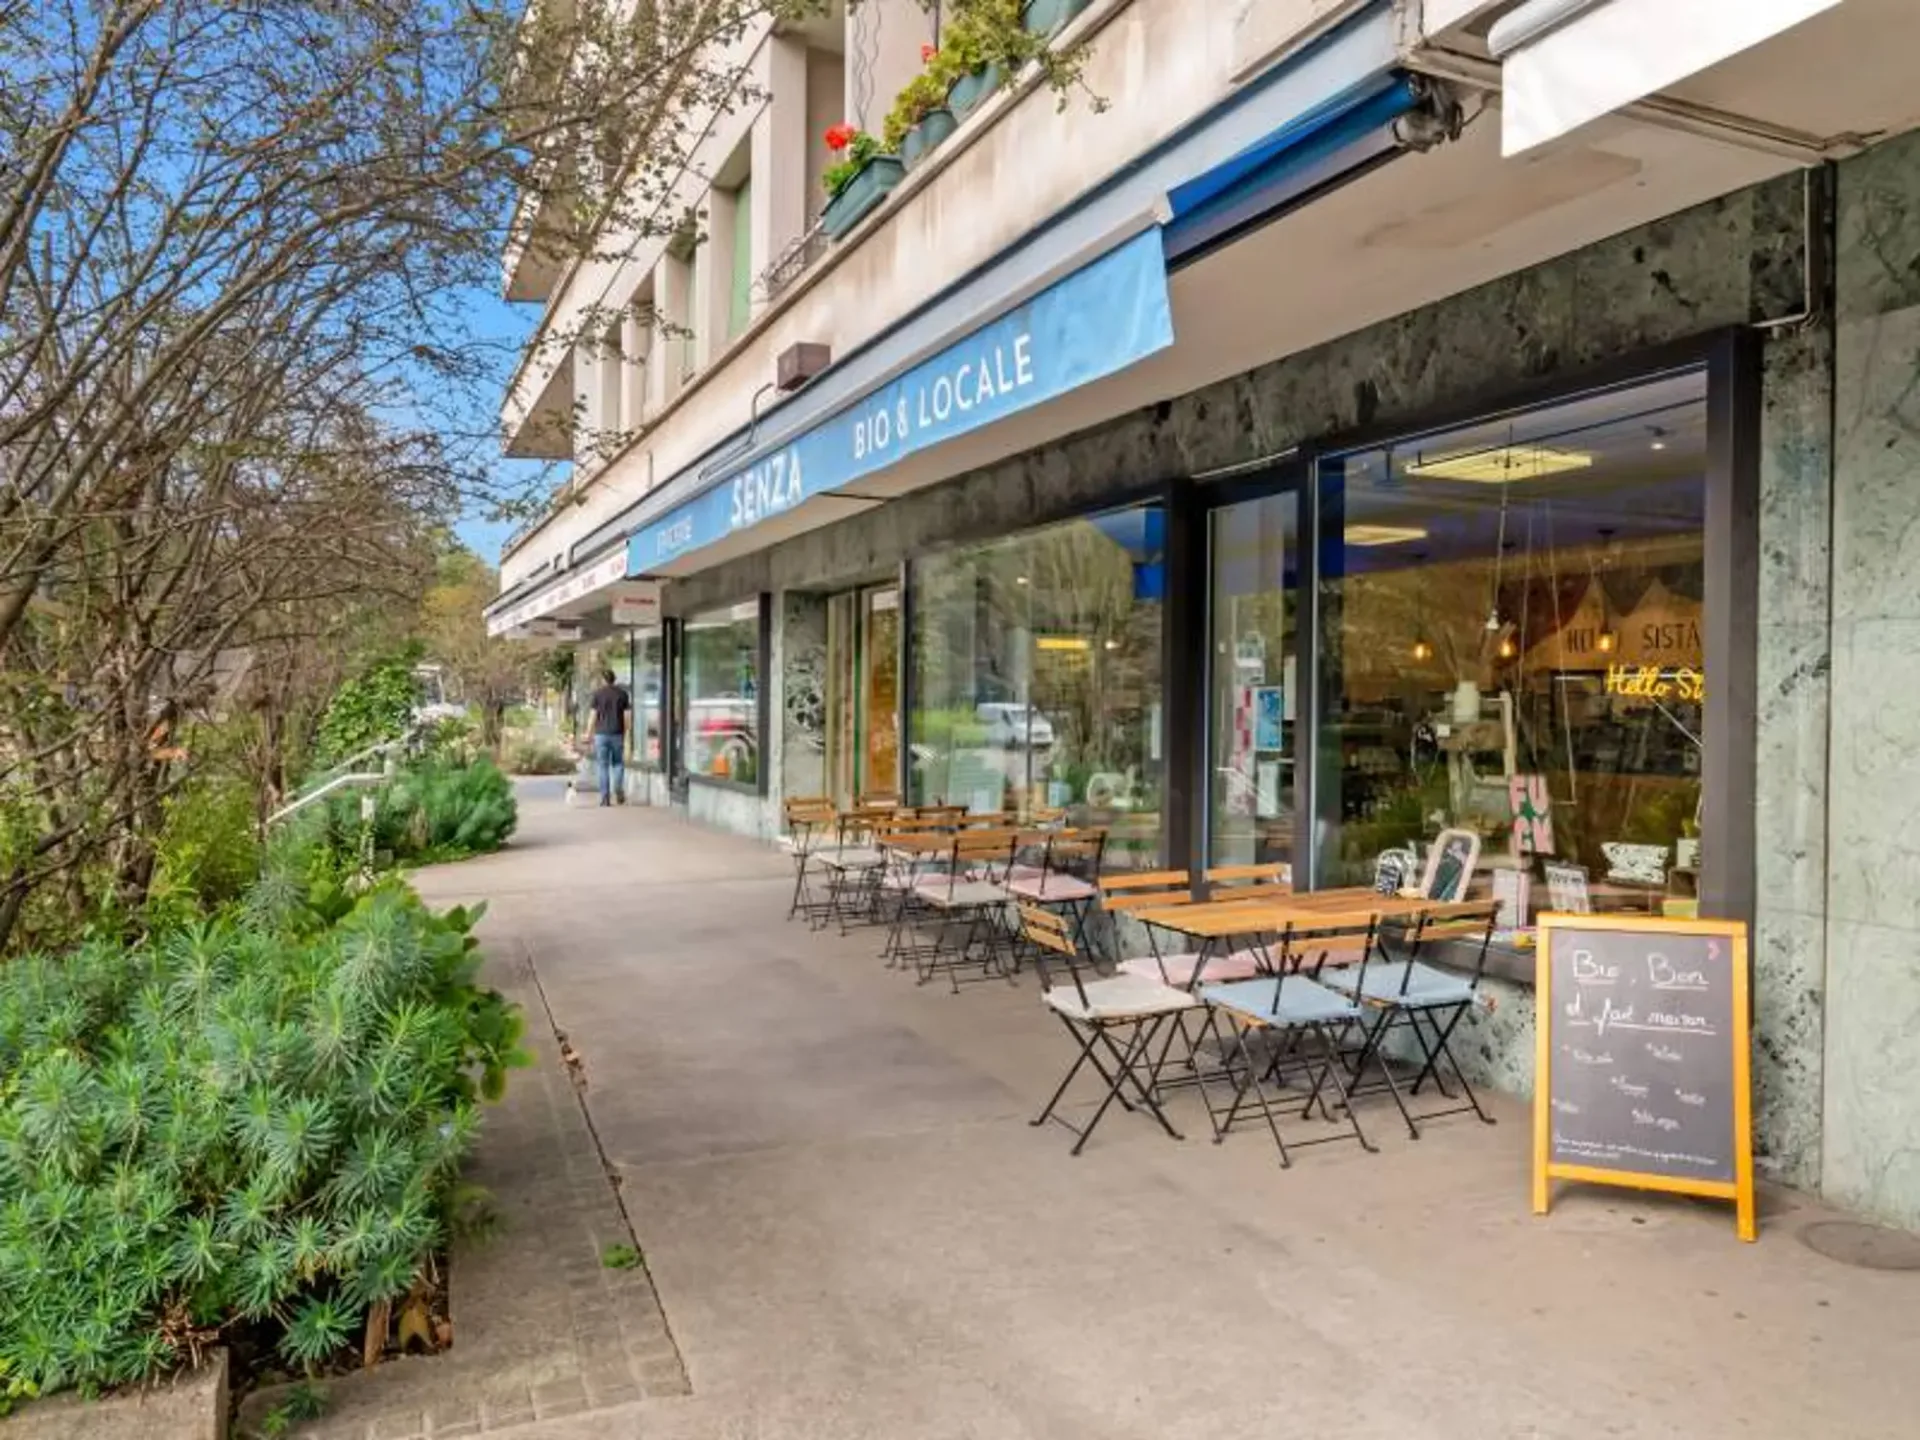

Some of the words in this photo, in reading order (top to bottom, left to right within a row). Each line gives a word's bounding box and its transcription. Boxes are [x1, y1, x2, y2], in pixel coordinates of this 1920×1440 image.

[731, 442, 802, 528] SENZA
[854, 409, 890, 460] BIO
[917, 333, 1034, 429] LOCALE
[1607, 662, 1672, 697] Hello
[1647, 952, 1710, 985] Bon
